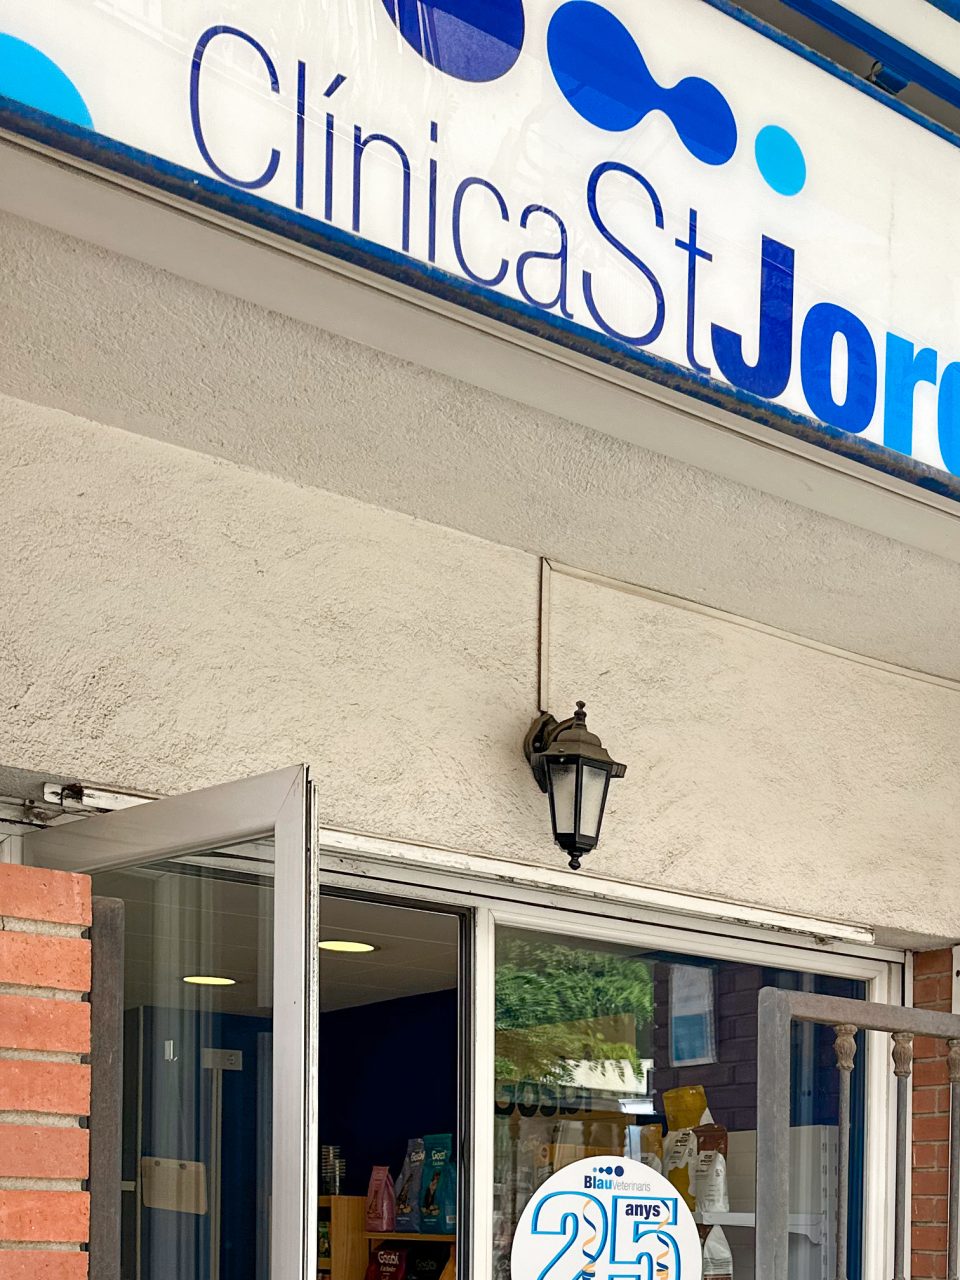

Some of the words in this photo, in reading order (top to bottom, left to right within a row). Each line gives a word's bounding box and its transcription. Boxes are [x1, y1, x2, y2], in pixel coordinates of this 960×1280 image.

[584, 1175, 613, 1190] Blau
[612, 1179, 651, 1192] Veterinaris
[625, 1203, 661, 1220] anys
